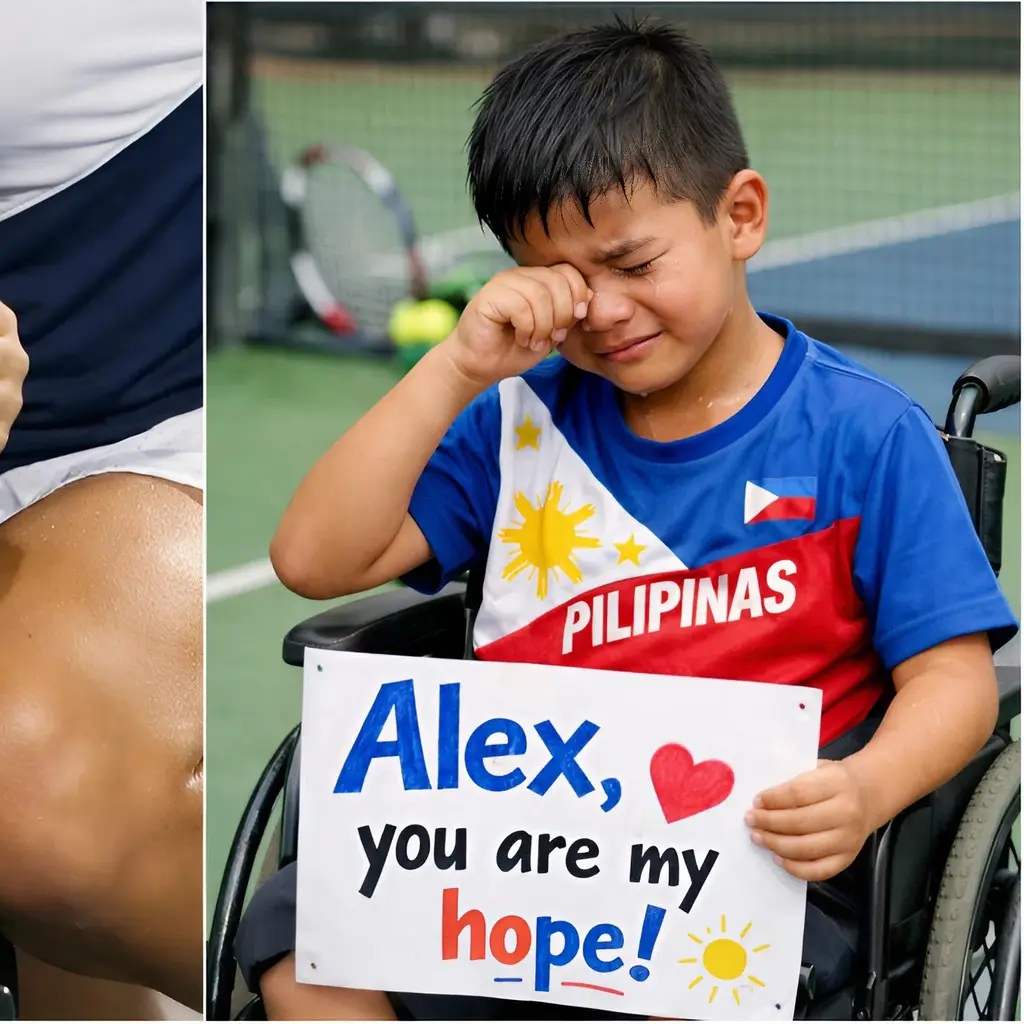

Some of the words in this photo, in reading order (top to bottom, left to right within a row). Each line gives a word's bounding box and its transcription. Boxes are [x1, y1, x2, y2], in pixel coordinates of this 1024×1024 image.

[561, 559, 798, 656] PILIPINAS
[333, 678, 624, 813] Alex,
[357, 823, 467, 899] you
[495, 830, 601, 879] are
[629, 843, 720, 914] my
[441, 887, 667, 993] hope!
